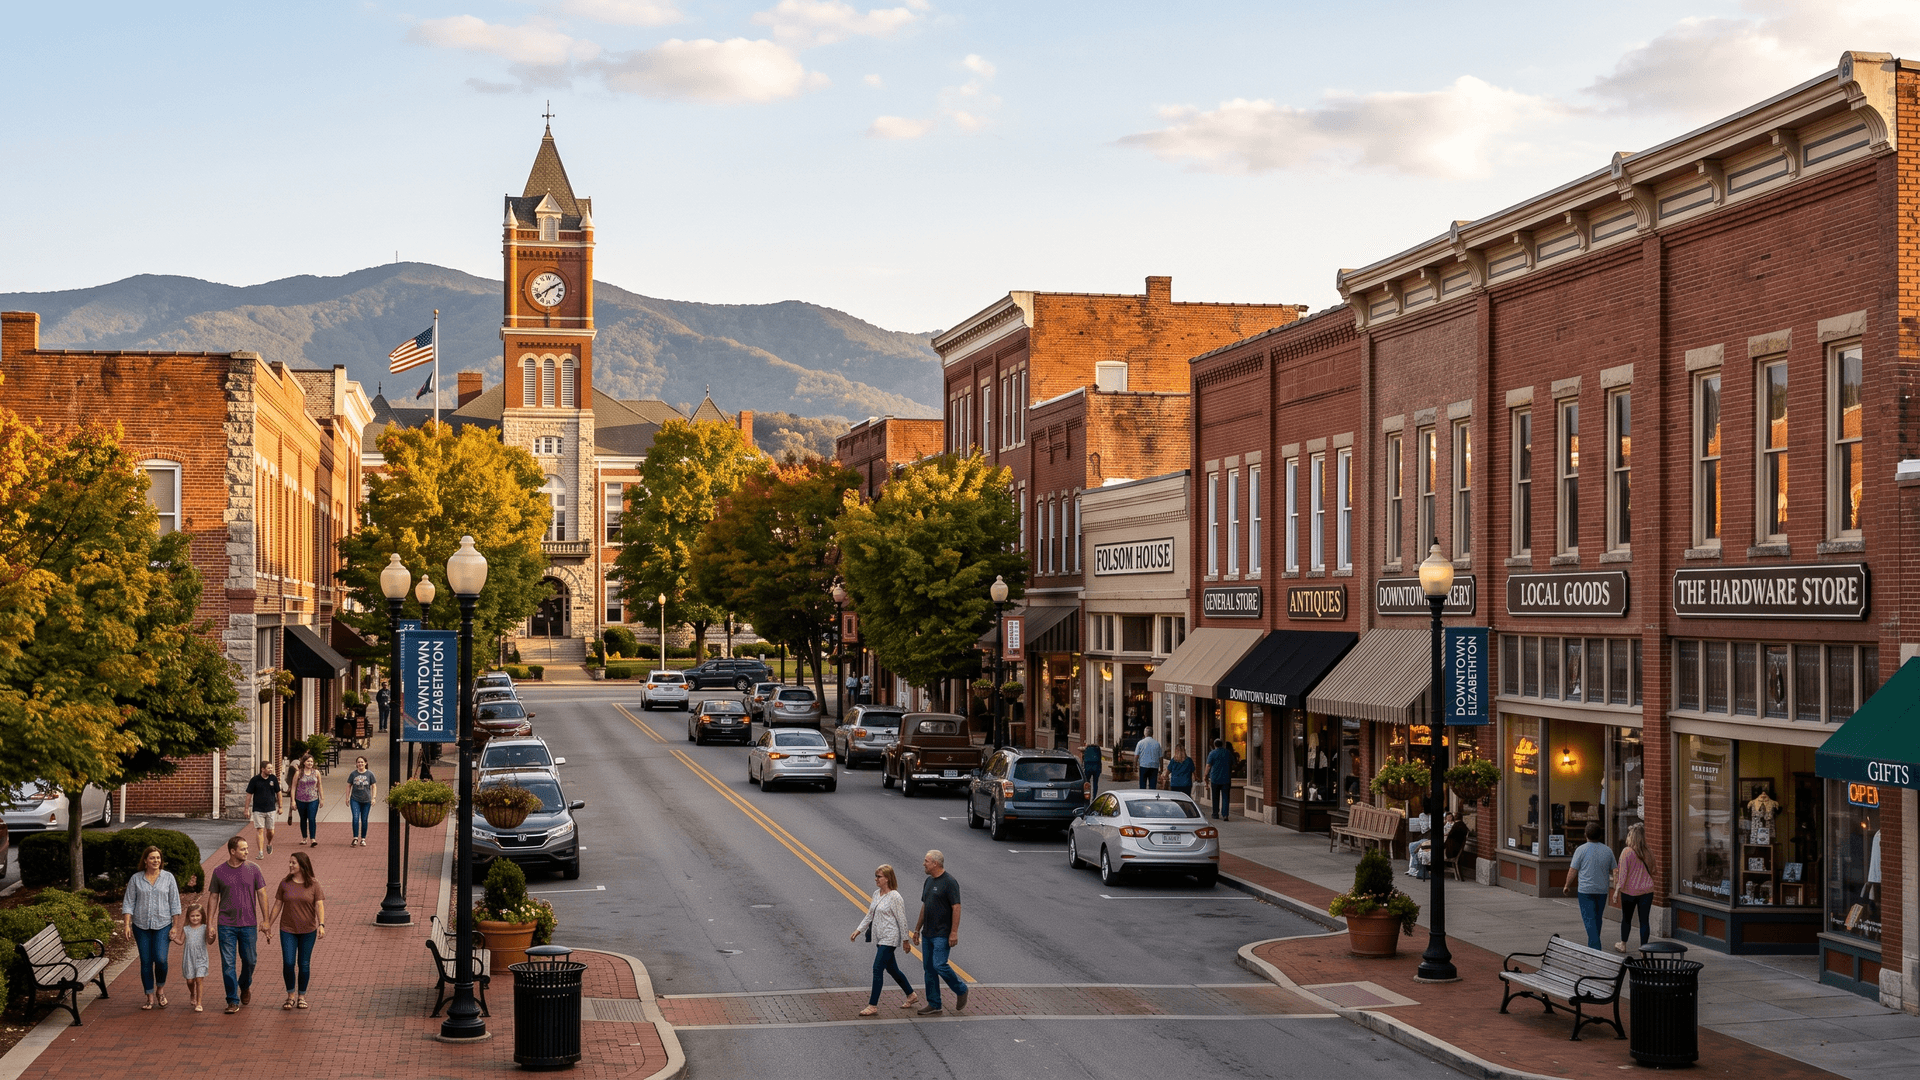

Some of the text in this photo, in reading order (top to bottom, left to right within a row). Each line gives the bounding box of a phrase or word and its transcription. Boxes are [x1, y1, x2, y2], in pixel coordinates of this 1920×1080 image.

[1096, 543, 1171, 571] FOLSOM HOUSE
[1205, 592, 1258, 611] GENERAL STORE
[1289, 590, 1341, 618] ANTIQUES
[1443, 585, 1471, 606] KERY
[1520, 581, 1610, 606] LOCAL GOODS
[1677, 576, 1859, 606] THE HARDWARE STORE
[417, 641, 430, 732] DOWNTOWN
[432, 641, 444, 732] ELIZABETHTON
[1456, 636, 1466, 716] DOWNTOWN
[1468, 636, 1477, 716] ELIZABETHTON
[1229, 687, 1265, 703] DOWNTOWN
[1867, 761, 1910, 785] GIFTS
[1849, 783, 1879, 805] OPEN
